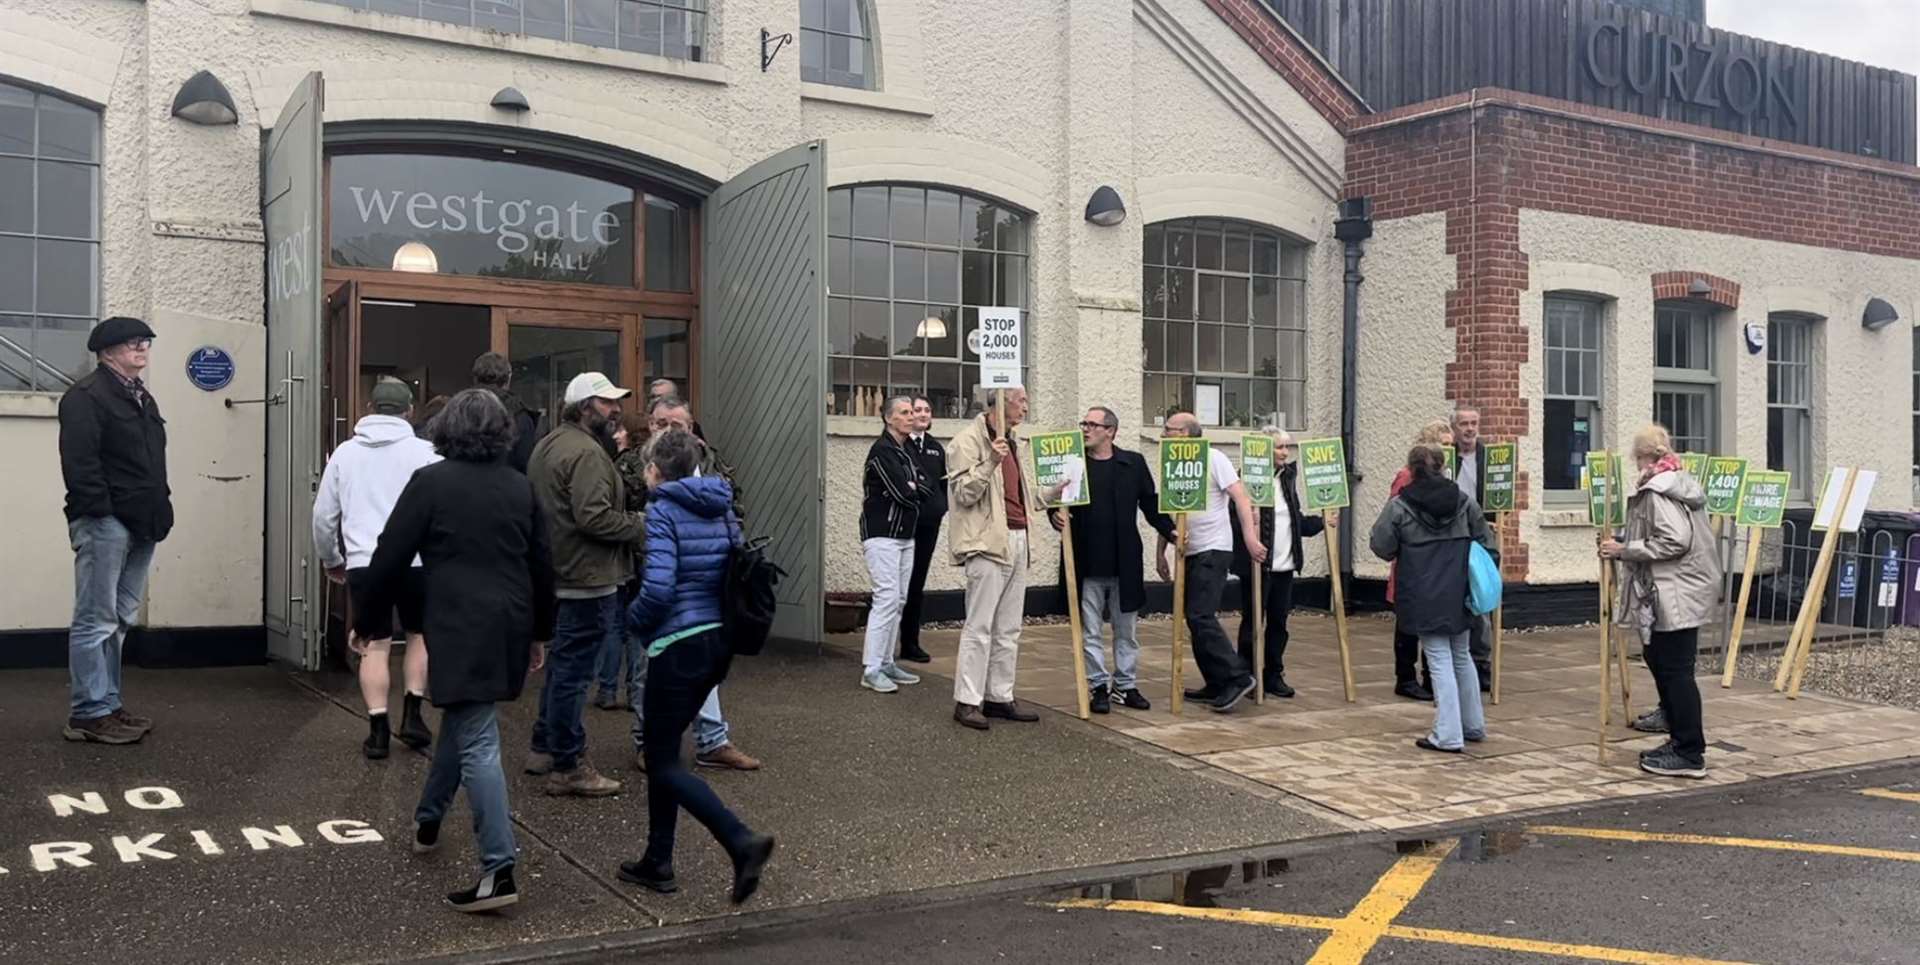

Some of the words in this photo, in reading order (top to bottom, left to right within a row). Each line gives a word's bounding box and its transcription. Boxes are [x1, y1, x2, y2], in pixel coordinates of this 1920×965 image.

[1587, 25, 1798, 126] CURZON
[349, 186, 620, 254] westgate
[533, 250, 591, 271] HALL
[985, 319, 1015, 331] STOP
[983, 334, 1018, 349] 2,000
[985, 351, 1016, 360] HOUSES
[1040, 436, 1073, 455] STOP
[1169, 443, 1201, 460] STOP
[1246, 440, 1267, 457] STOP
[1306, 445, 1337, 464] SAVE
[1490, 448, 1510, 464] STOP
[1164, 461, 1204, 479] 1,400
[1714, 461, 1740, 474] STOP
[1168, 480, 1200, 490] HOUSES
[1743, 495, 1783, 508] SEWAGE
[47, 786, 185, 817] NO
[0, 820, 385, 874] RKING
